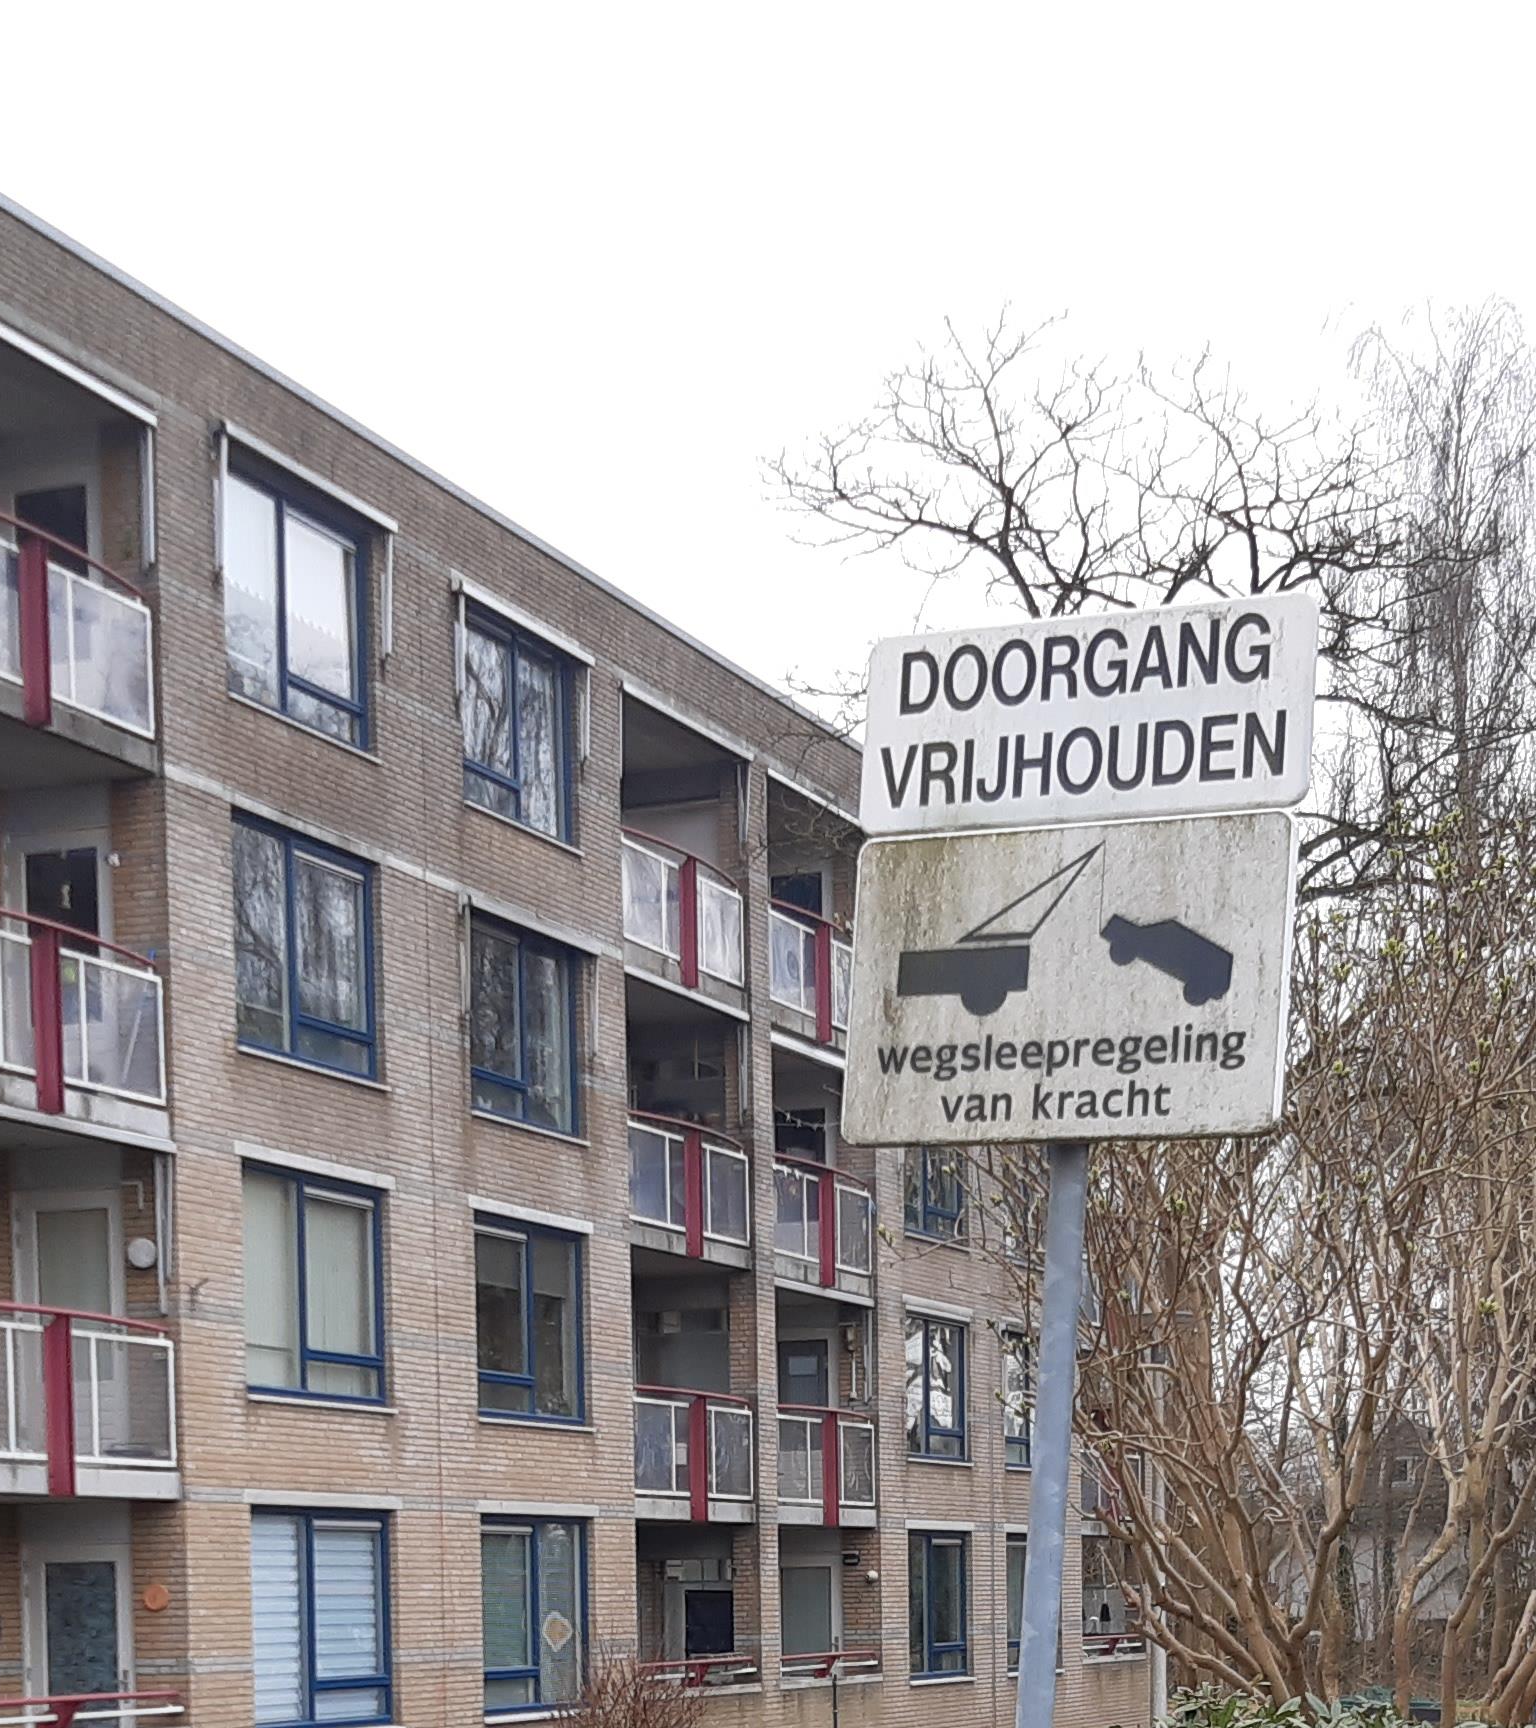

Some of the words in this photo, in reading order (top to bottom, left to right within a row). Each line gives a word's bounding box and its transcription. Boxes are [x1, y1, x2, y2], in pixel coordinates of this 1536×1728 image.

[899, 612, 1271, 716] DOORGANG
[880, 709, 1287, 809] VRIJHOUDEN
[877, 1023, 1247, 1081] wegsleepregeling
[940, 1091, 1012, 1124] van
[1032, 1079, 1171, 1120] kracht
